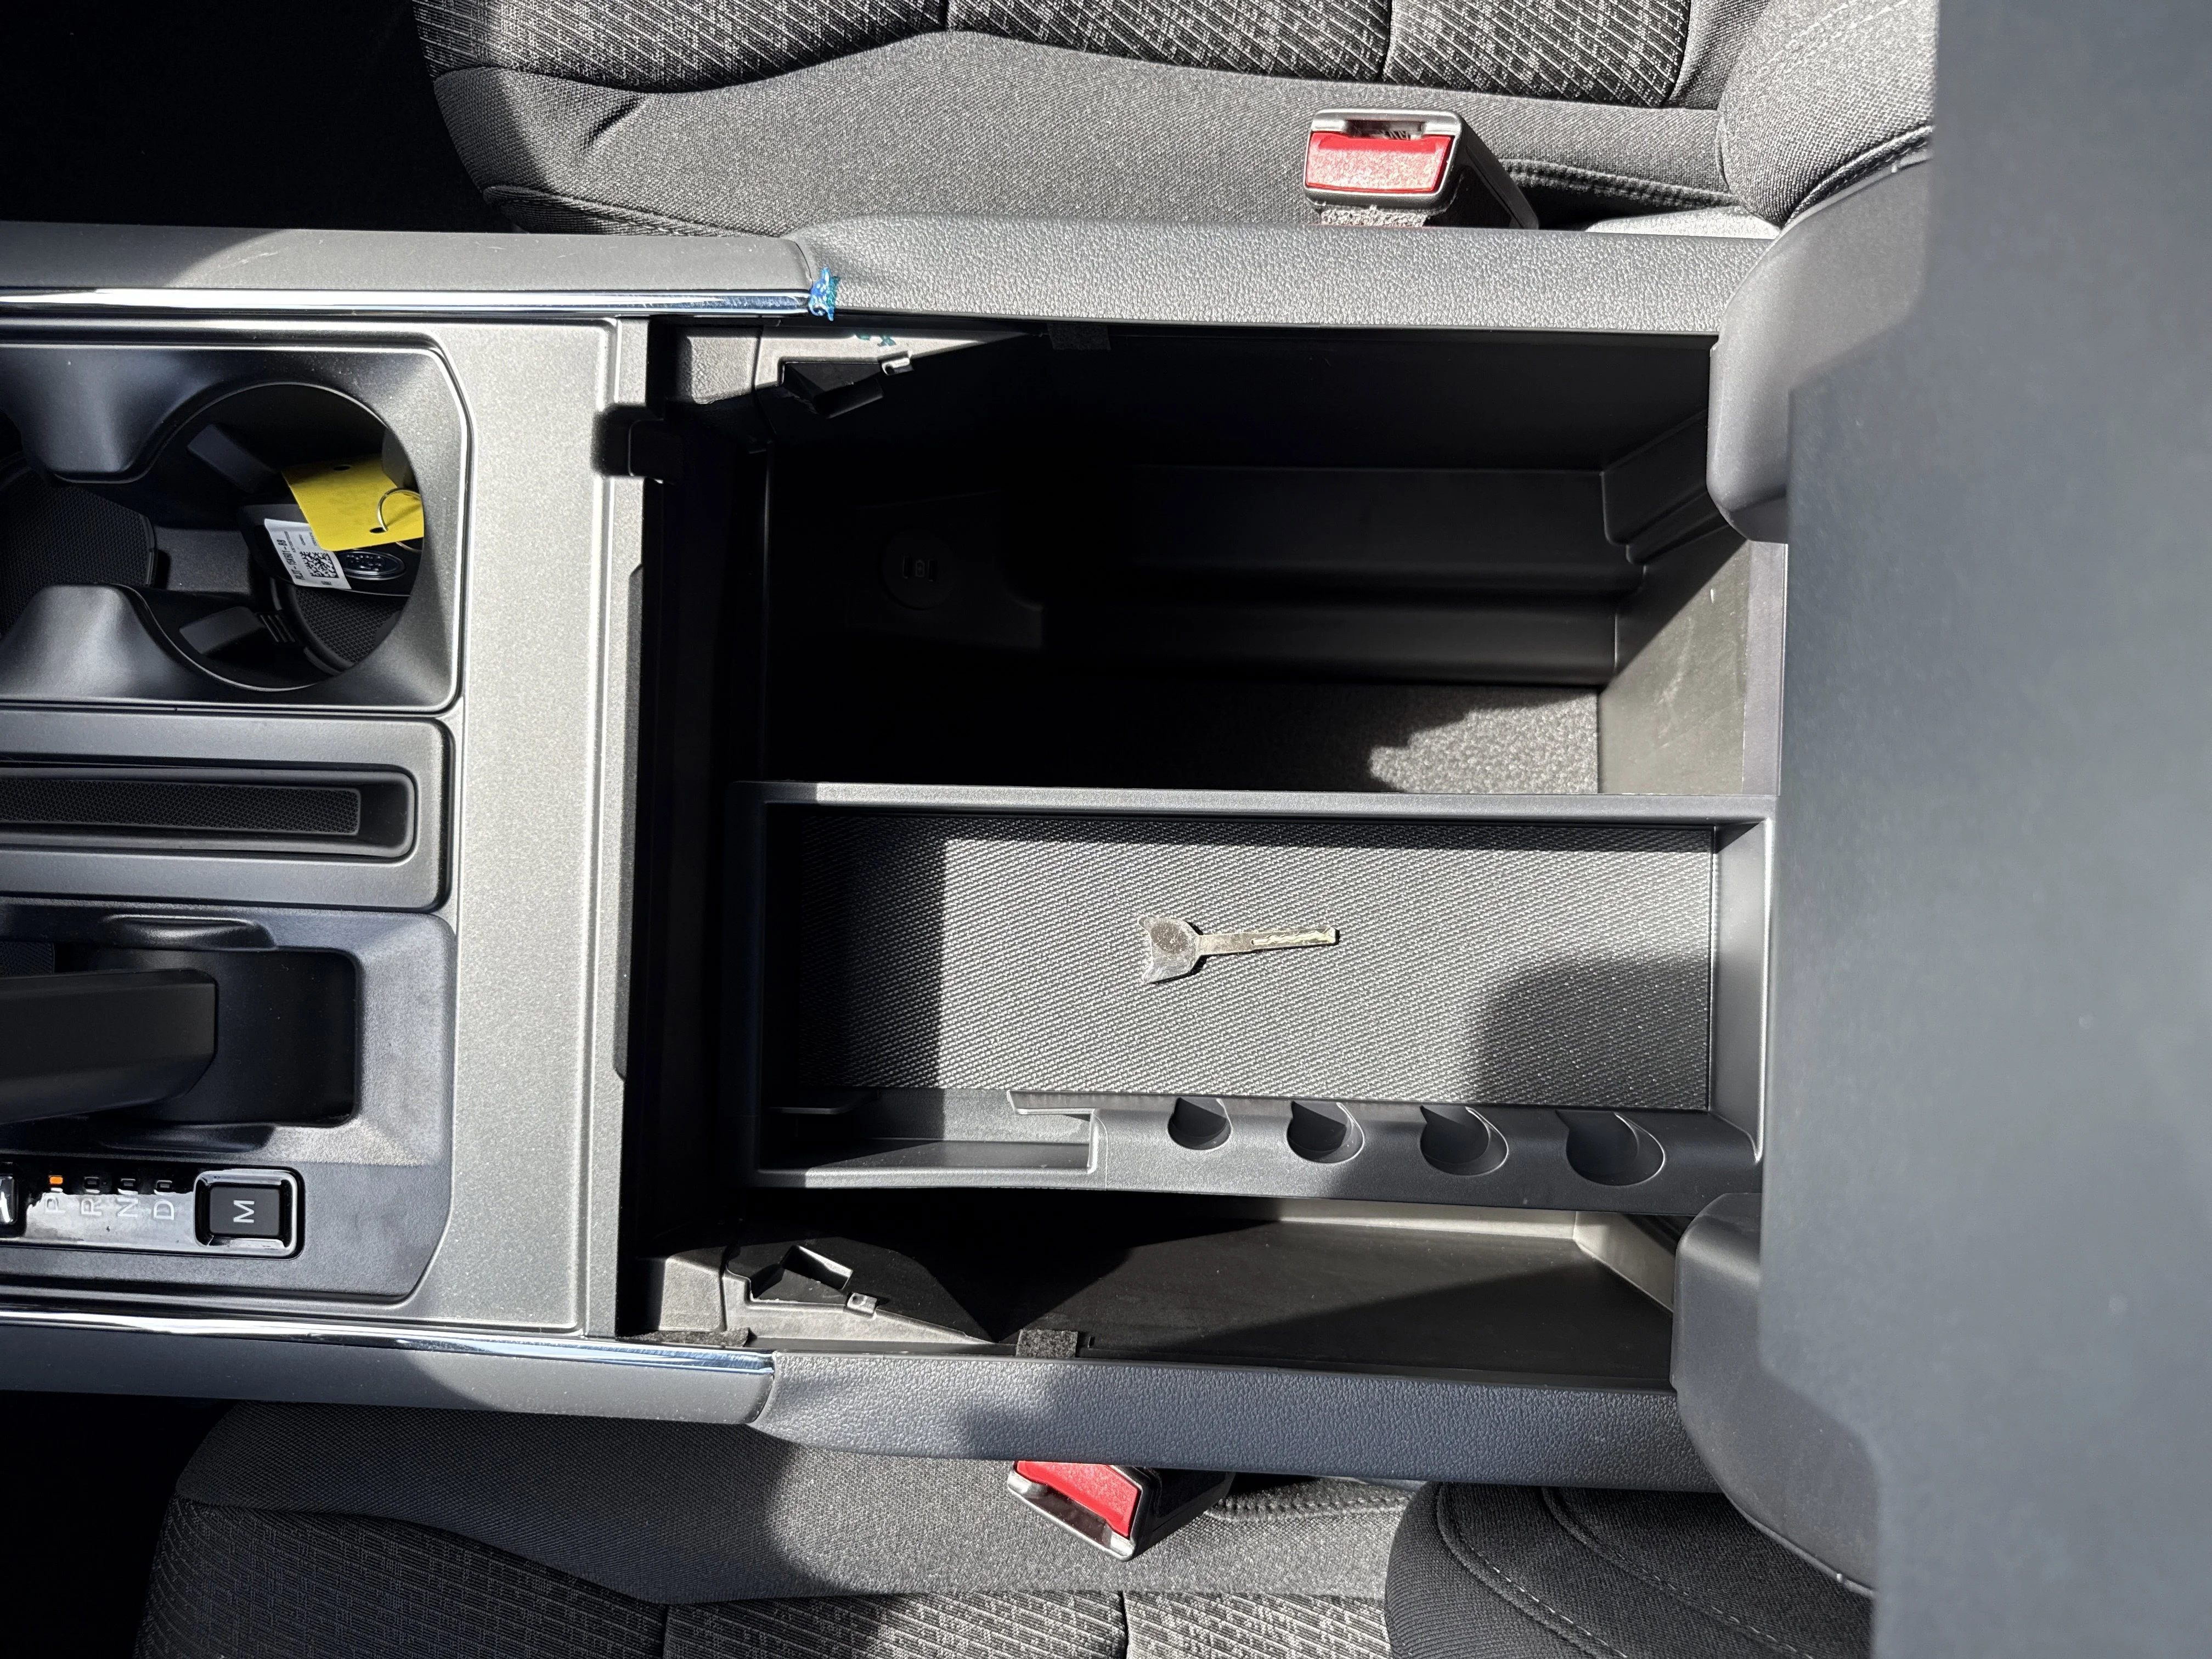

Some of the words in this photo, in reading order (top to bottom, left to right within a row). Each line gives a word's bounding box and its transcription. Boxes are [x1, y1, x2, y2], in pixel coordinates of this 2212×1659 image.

[46, 1196, 65, 1214] P
[82, 1198, 102, 1216] R
[117, 1198, 138, 1218] N
[154, 1200, 174, 1221] D
[233, 1200, 255, 1223] M
